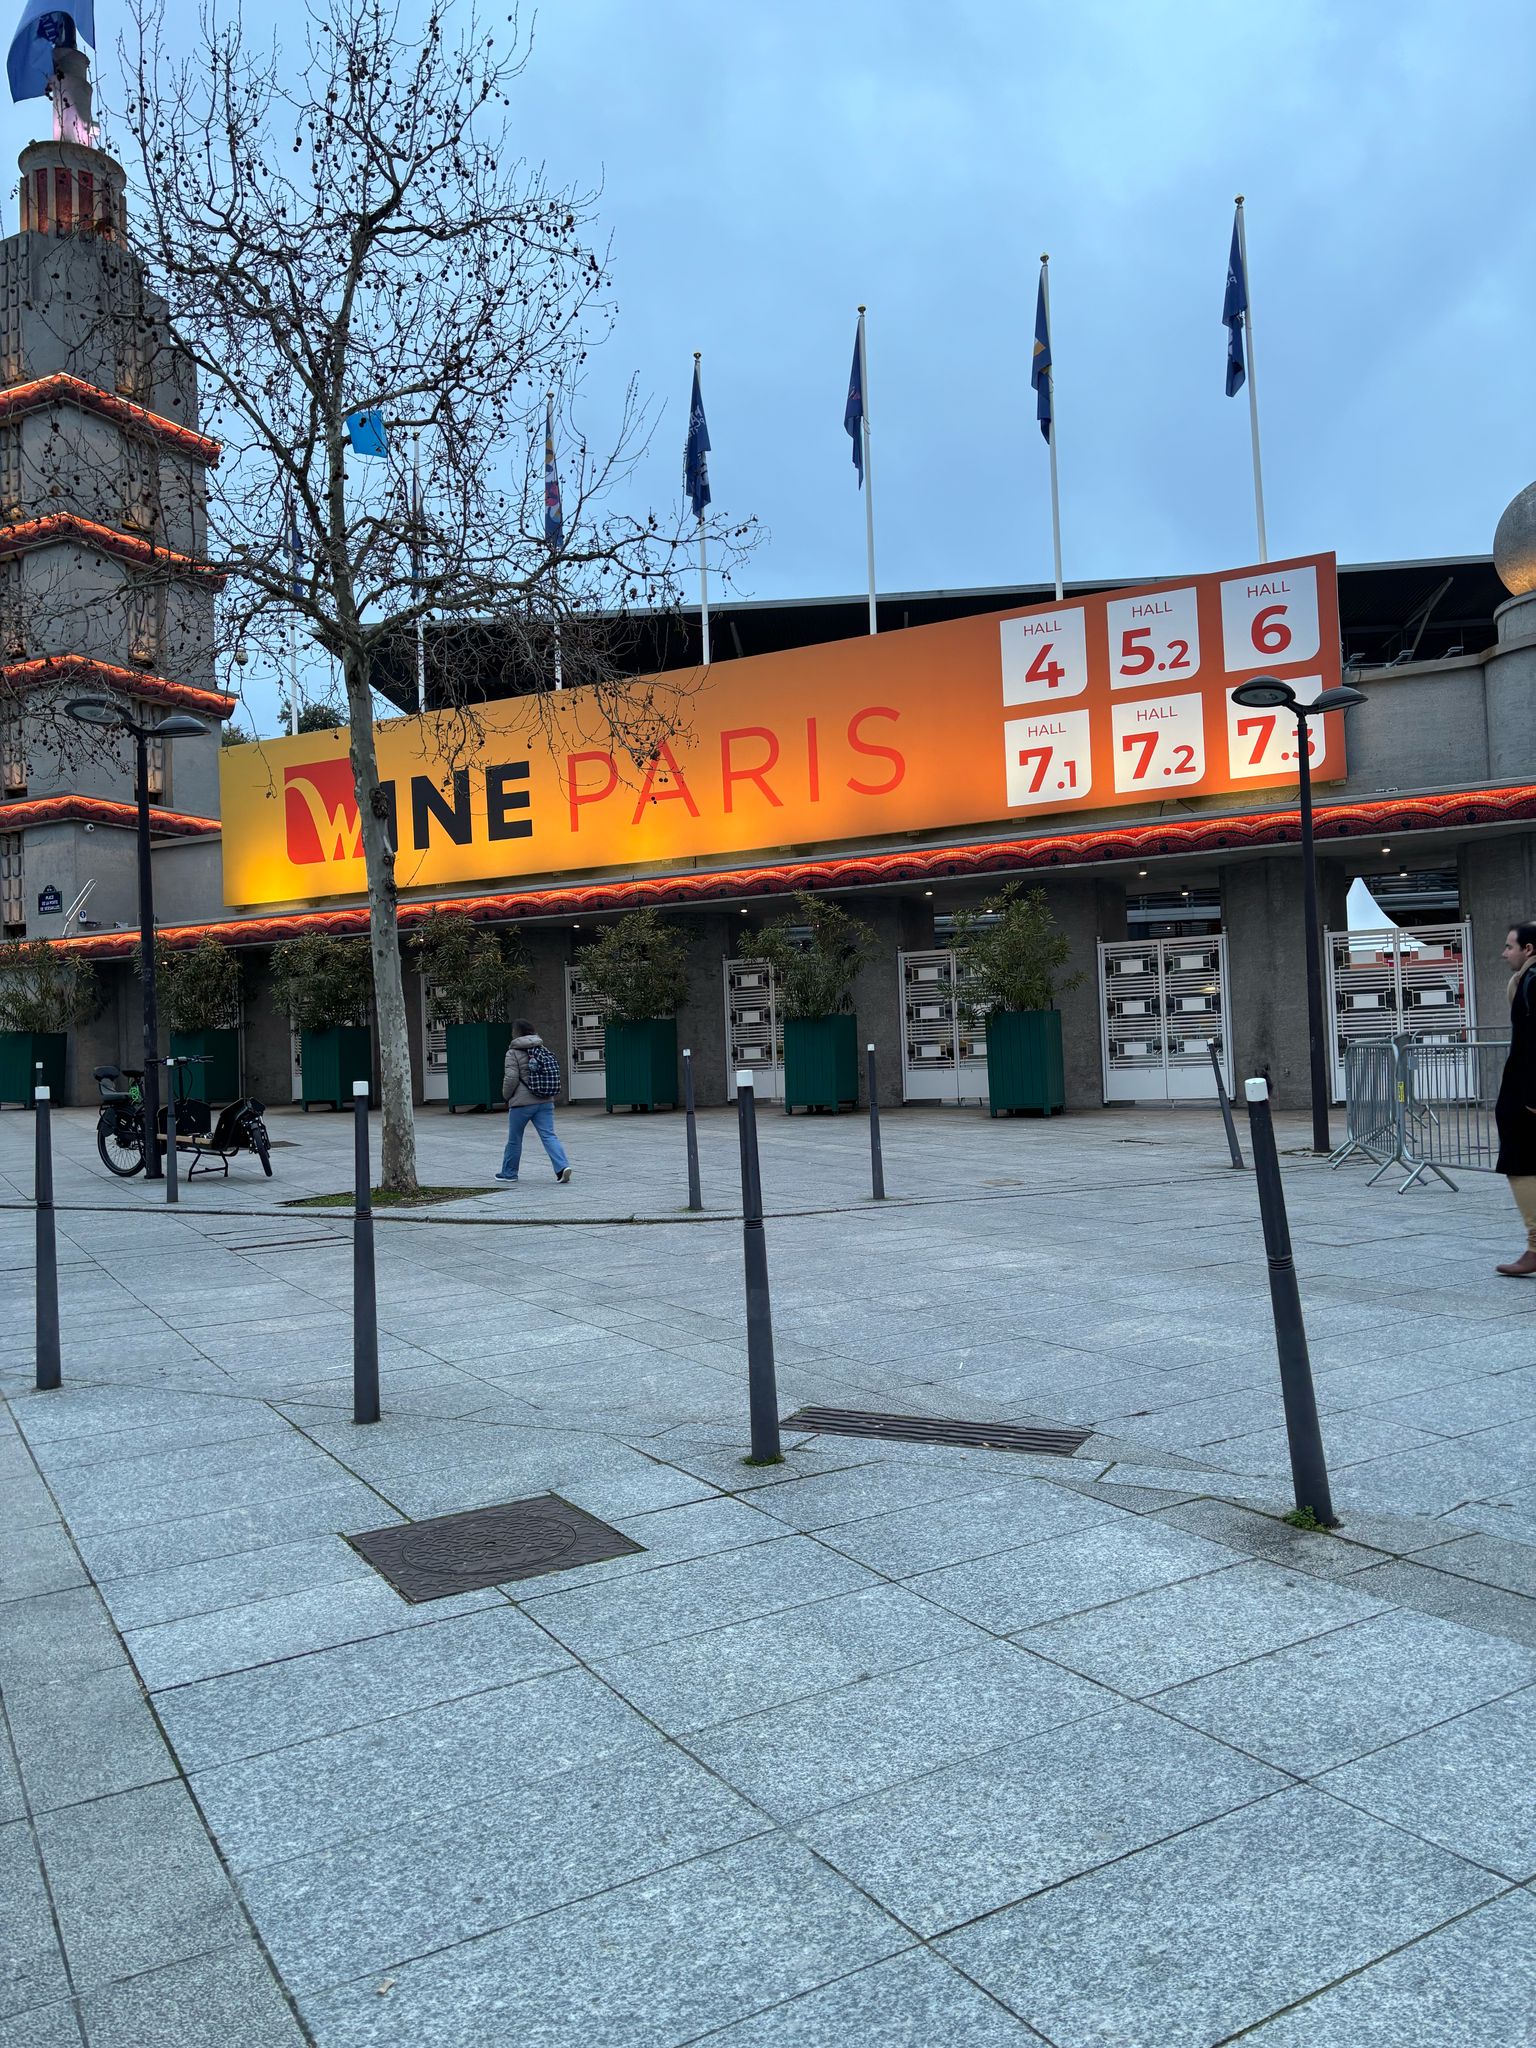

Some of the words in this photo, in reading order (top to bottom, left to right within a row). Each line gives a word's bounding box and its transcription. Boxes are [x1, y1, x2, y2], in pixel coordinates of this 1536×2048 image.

[1131, 601, 1173, 618] HALL
[1247, 581, 1291, 598] HALL
[1023, 620, 1062, 636] HALL
[1251, 605, 1292, 655] 6
[1025, 643, 1065, 689] 4
[1119, 627, 1191, 676] 5.2
[1027, 722, 1066, 738] HALL
[1136, 705, 1178, 722] HALL
[1018, 746, 1077, 793] 7.1
[1122, 731, 1196, 780] 7.2
[284, 760, 533, 864] WINE
[567, 706, 906, 832] PARIS
